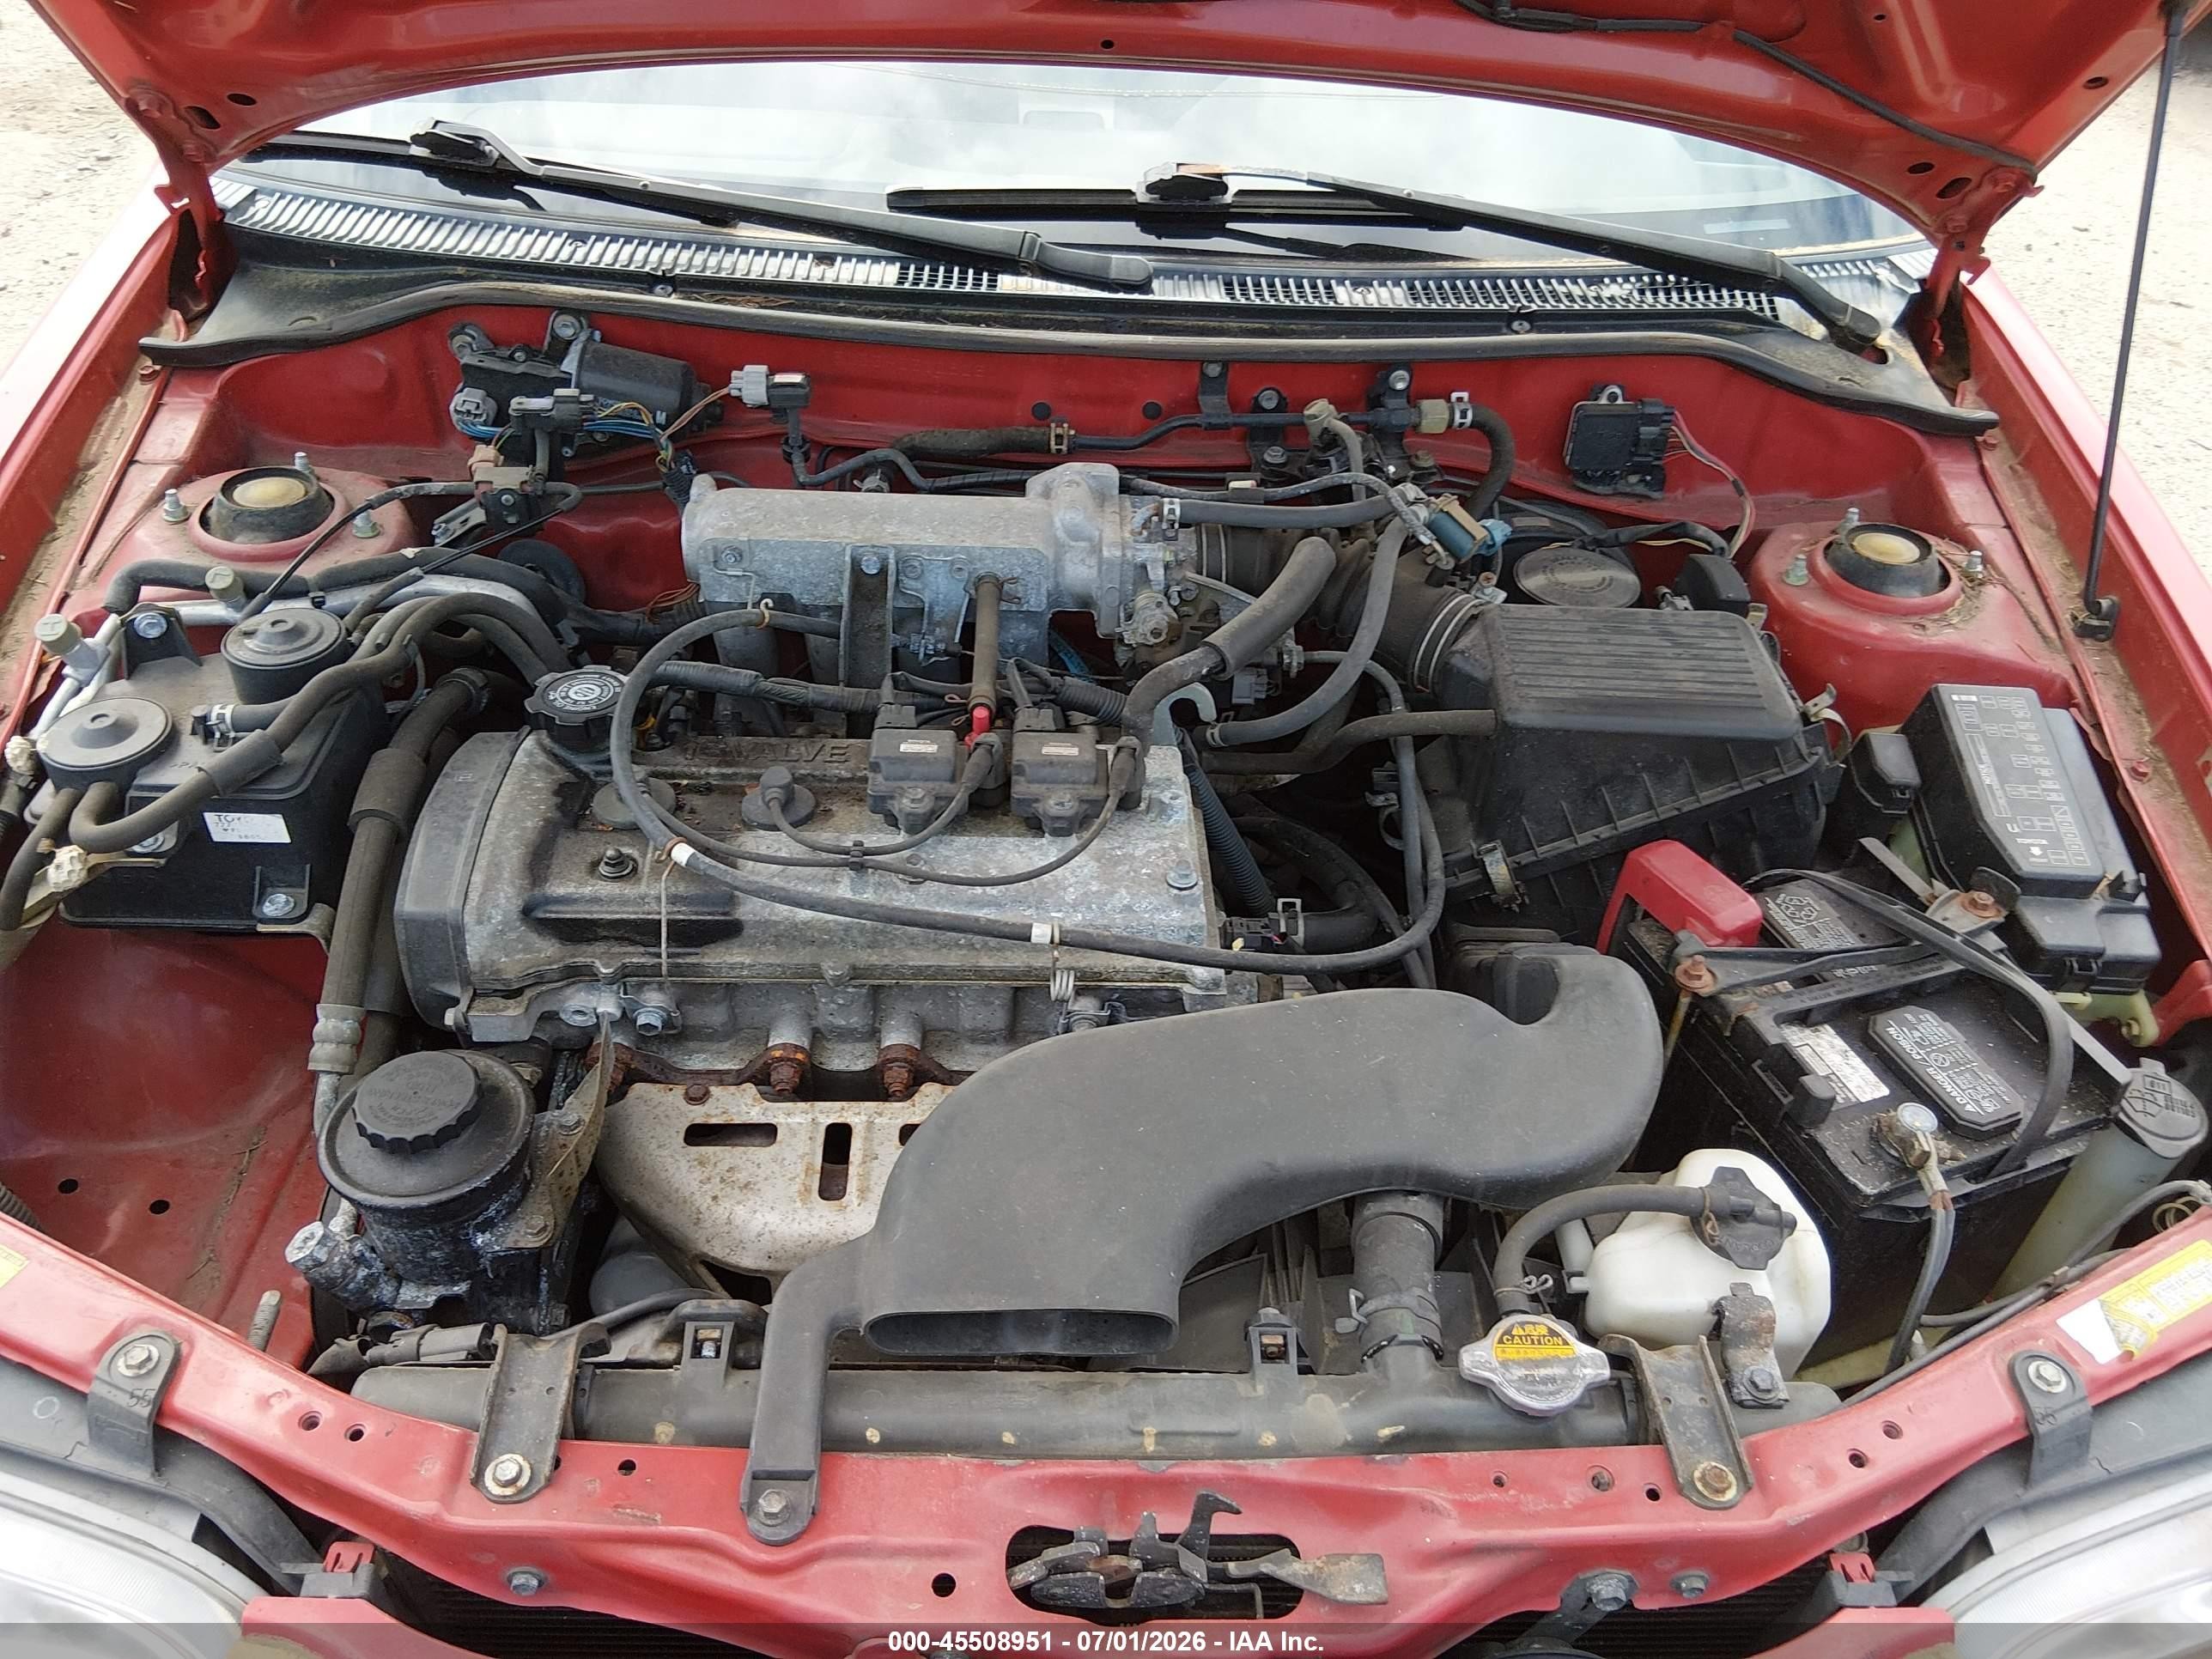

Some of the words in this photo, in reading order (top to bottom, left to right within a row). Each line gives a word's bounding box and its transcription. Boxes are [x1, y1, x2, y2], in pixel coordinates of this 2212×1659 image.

[1885, 1026, 1923, 1060] POISON
[1926, 1066, 1967, 1105] DANGER
[1503, 1335, 1564, 1346] CAUTION
